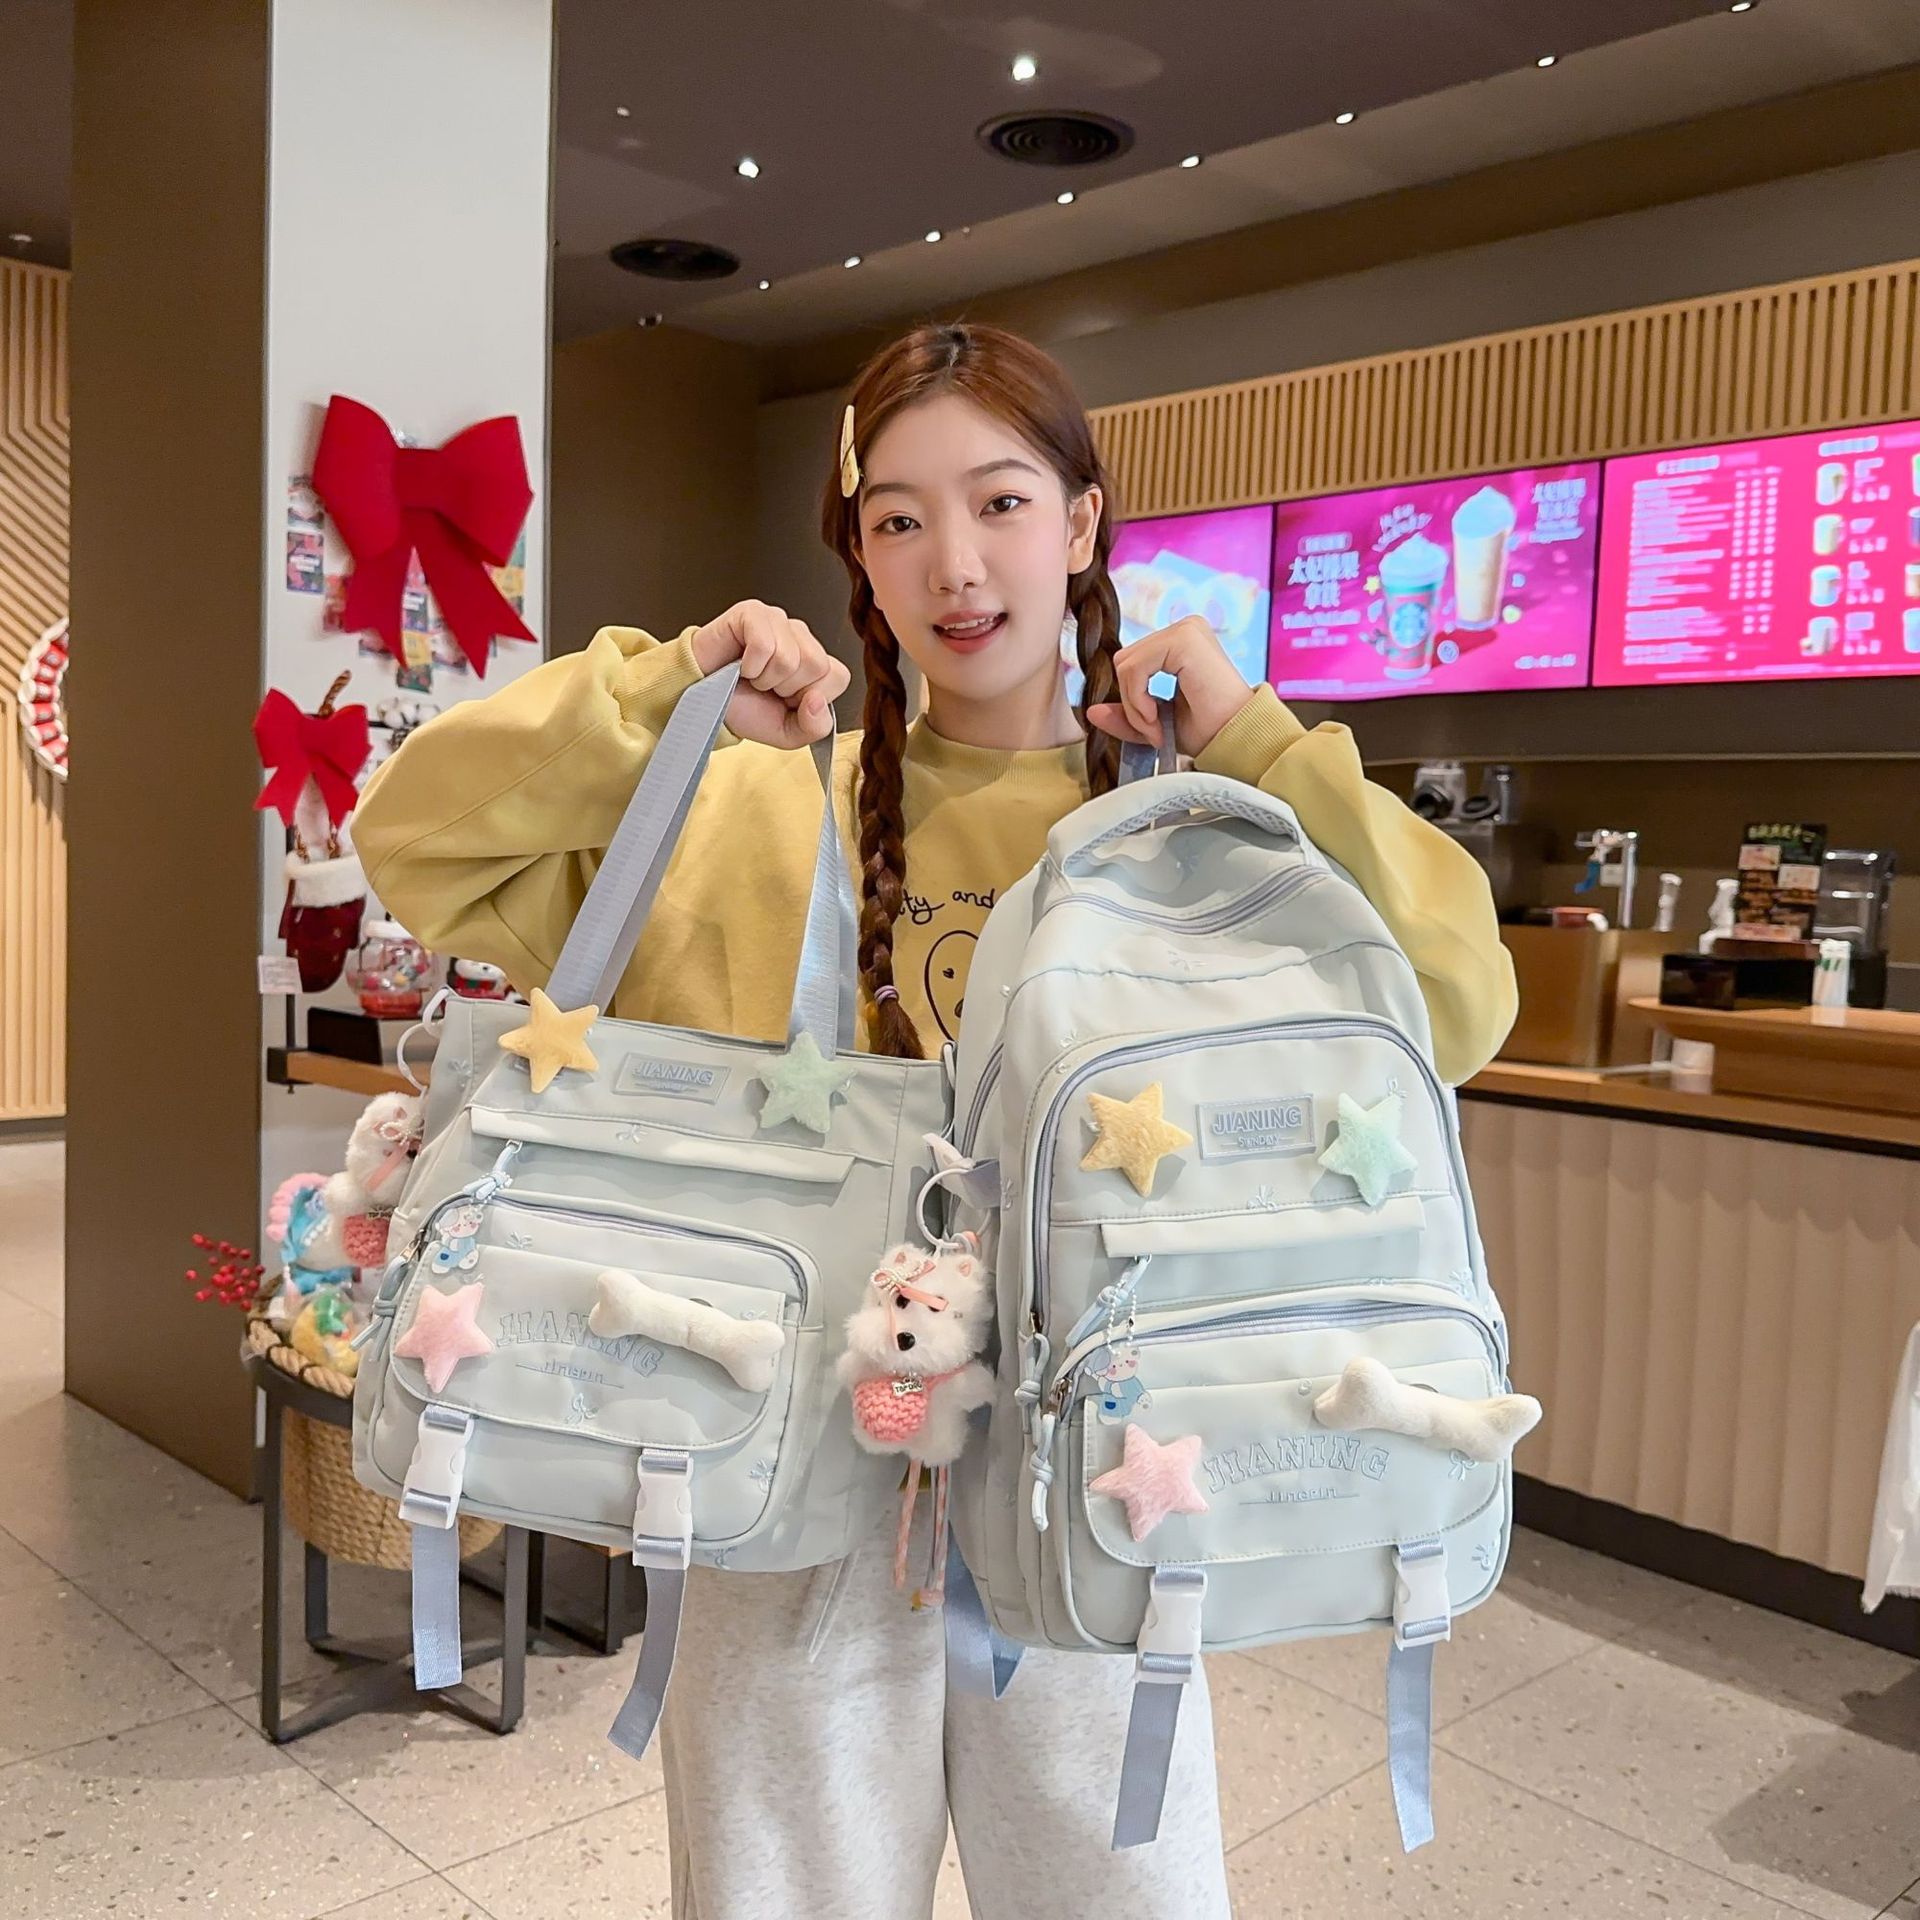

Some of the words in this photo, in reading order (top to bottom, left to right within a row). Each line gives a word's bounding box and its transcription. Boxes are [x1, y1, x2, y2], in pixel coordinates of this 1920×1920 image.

[900, 889, 945, 925] ty
[952, 888, 995, 909] and
[631, 1061, 715, 1086] JIANING
[1213, 1105, 1303, 1135] JIANING
[496, 1310, 664, 1378] JIANNG
[1203, 1434, 1390, 1494] JIANING
